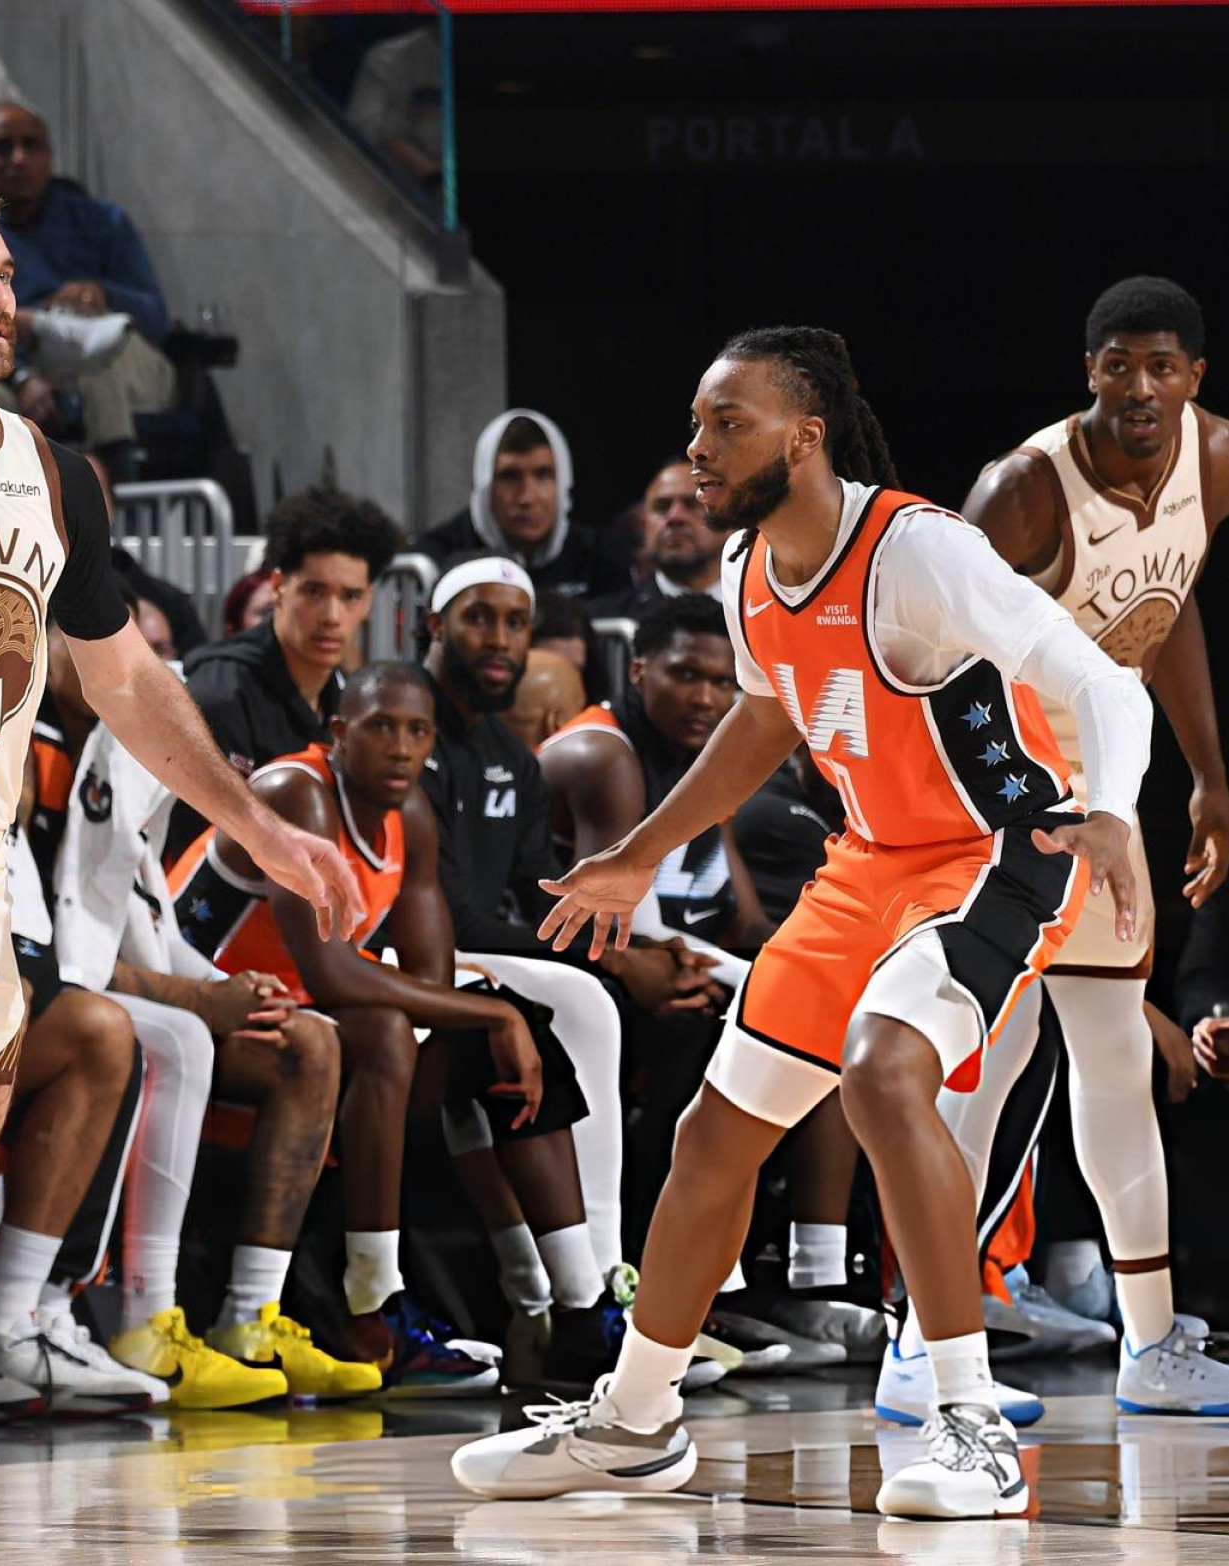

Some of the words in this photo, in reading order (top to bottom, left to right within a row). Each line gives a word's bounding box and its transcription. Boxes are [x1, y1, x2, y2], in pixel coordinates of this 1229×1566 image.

[646, 114, 868, 162] PORTAL
[886, 113, 926, 160] A
[1076, 547, 1197, 622] TOWN
[1085, 564, 1112, 593] The
[815, 615, 858, 626] RWANDA
[824, 604, 849, 615] VISIT
